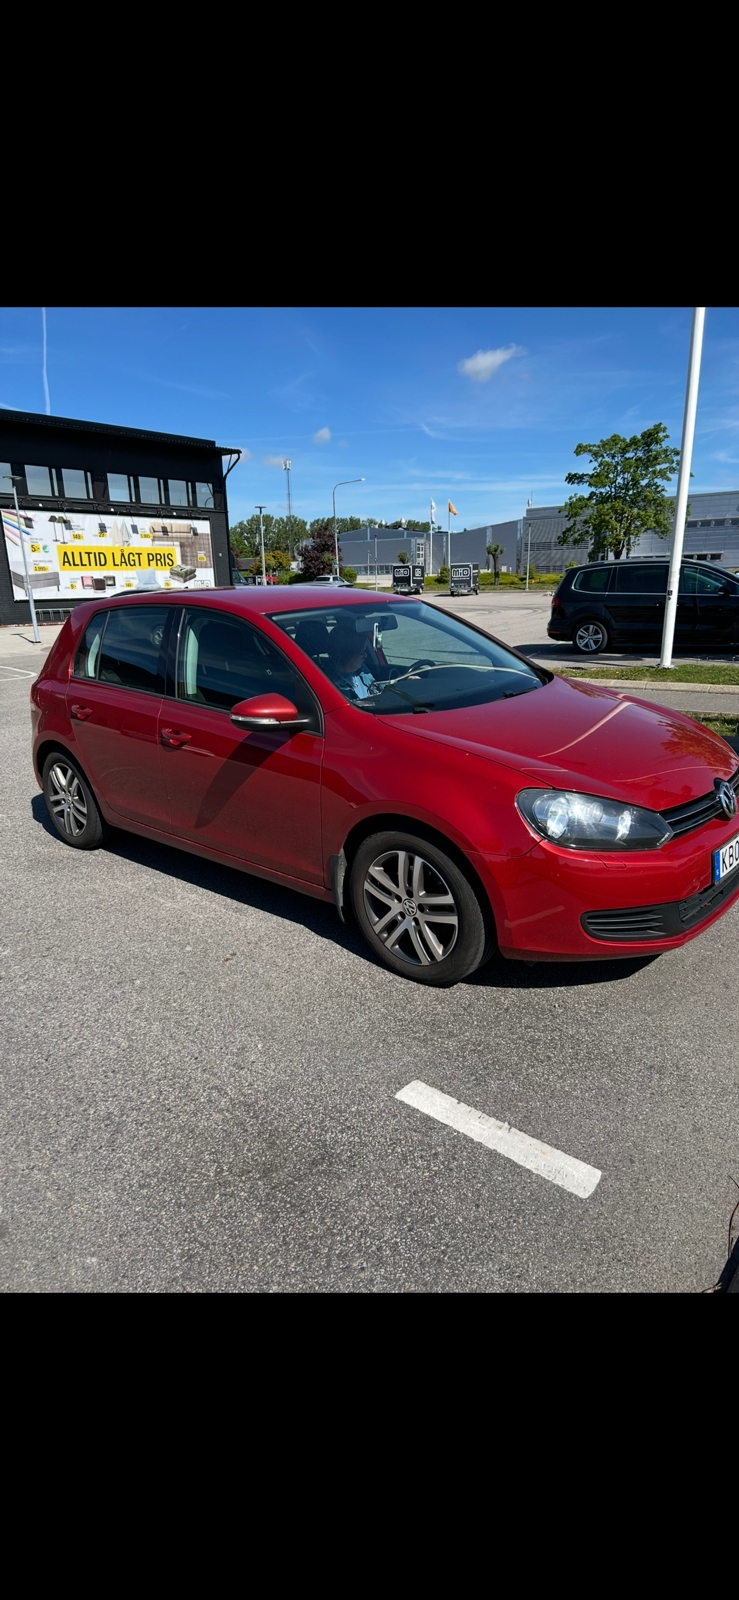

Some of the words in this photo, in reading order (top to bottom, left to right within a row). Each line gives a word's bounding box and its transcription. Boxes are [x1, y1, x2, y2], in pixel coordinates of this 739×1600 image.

[62, 551, 107, 567] ALLTID
[112, 549, 142, 567] LÅGT
[147, 552, 174, 567] PRIS
